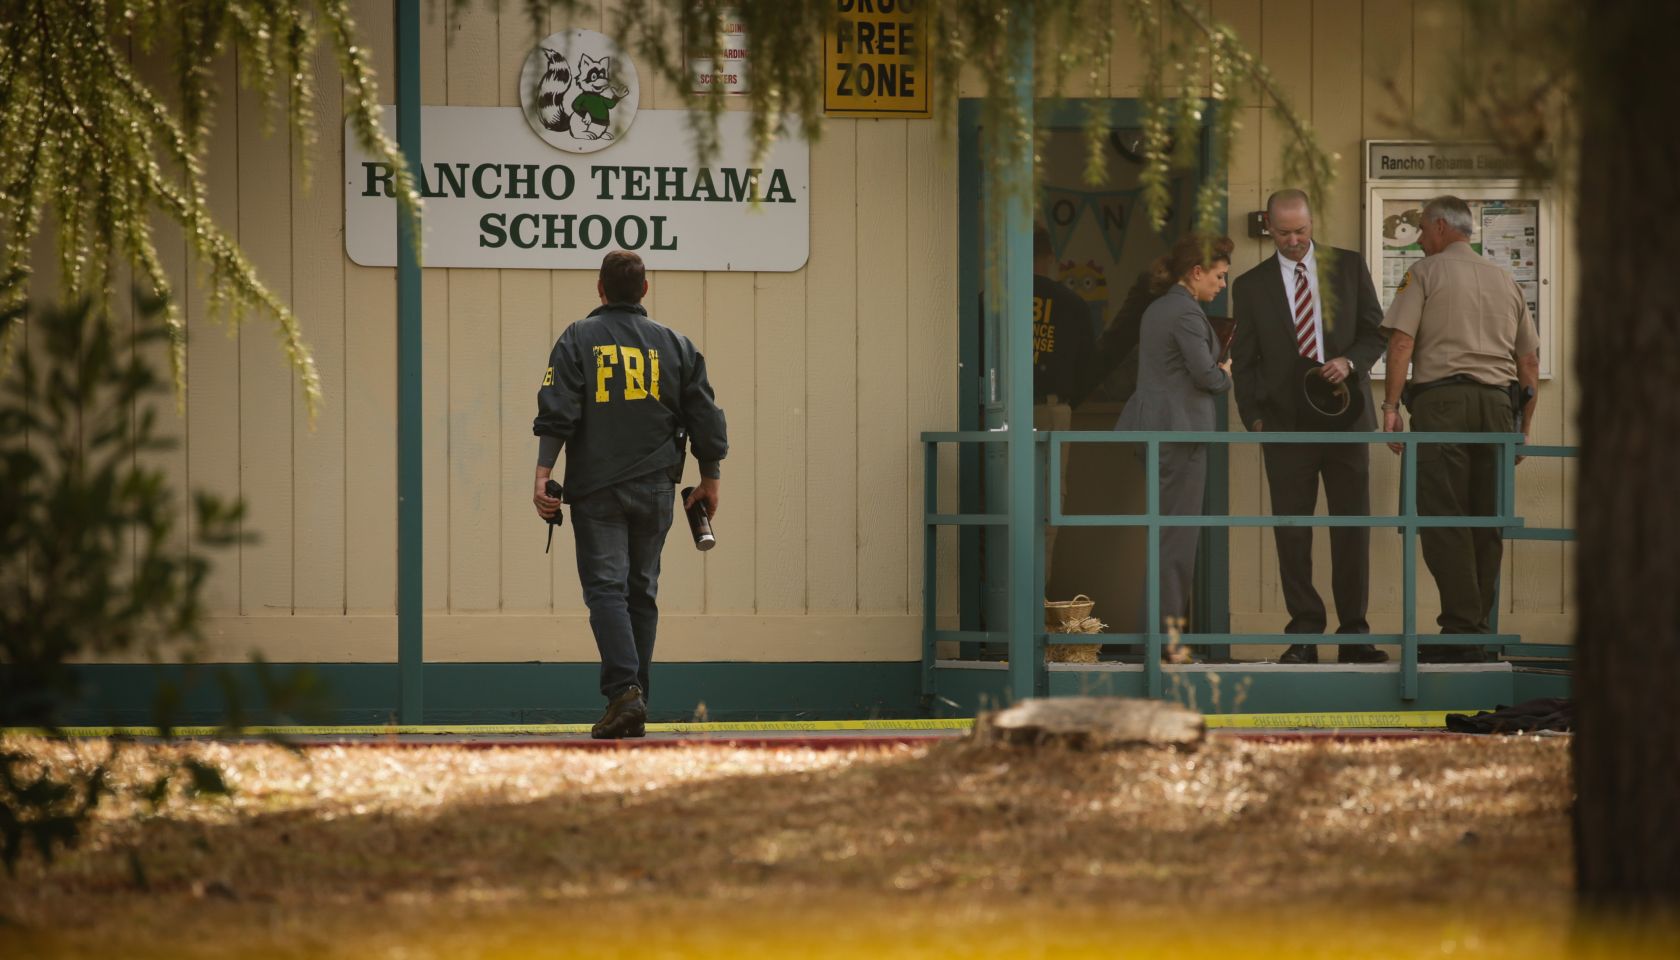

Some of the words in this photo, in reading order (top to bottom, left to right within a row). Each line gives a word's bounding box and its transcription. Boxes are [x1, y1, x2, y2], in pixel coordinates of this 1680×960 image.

[836, 22, 915, 55] FREE
[836, 63, 914, 97] ZONE
[1381, 155, 1425, 170] Rancho
[1428, 155, 1473, 170] Tehama
[591, 165, 797, 203] TEHAMA
[479, 212, 678, 251] SCHOOL
[1033, 296, 1053, 323] BI
[592, 344, 661, 403] FBI
